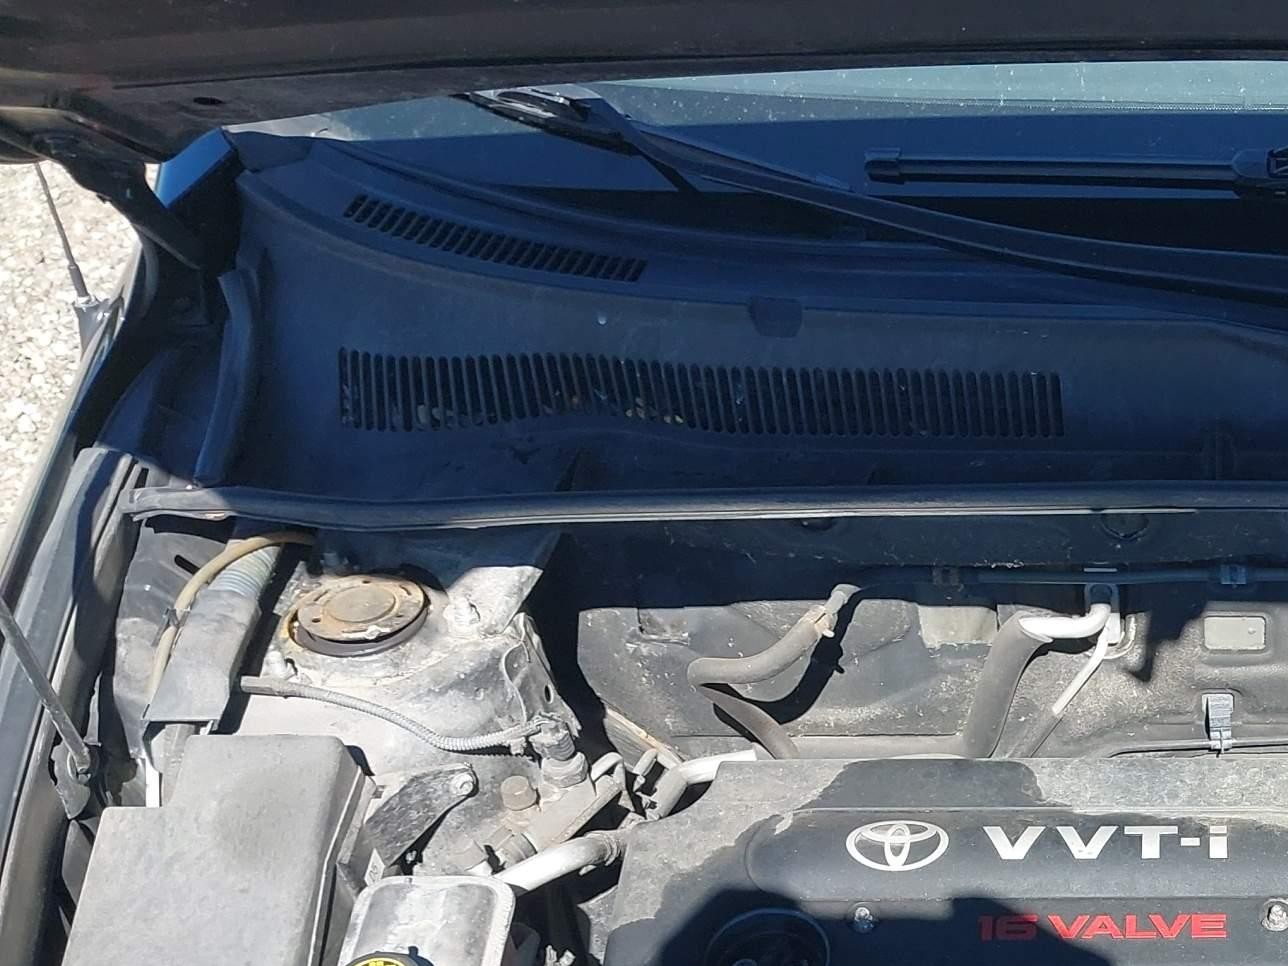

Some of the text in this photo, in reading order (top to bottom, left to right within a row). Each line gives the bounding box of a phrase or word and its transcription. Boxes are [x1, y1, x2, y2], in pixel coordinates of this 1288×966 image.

[983, 825, 1229, 860] VVT-i
[979, 914, 1227, 940] 16 VALVE
